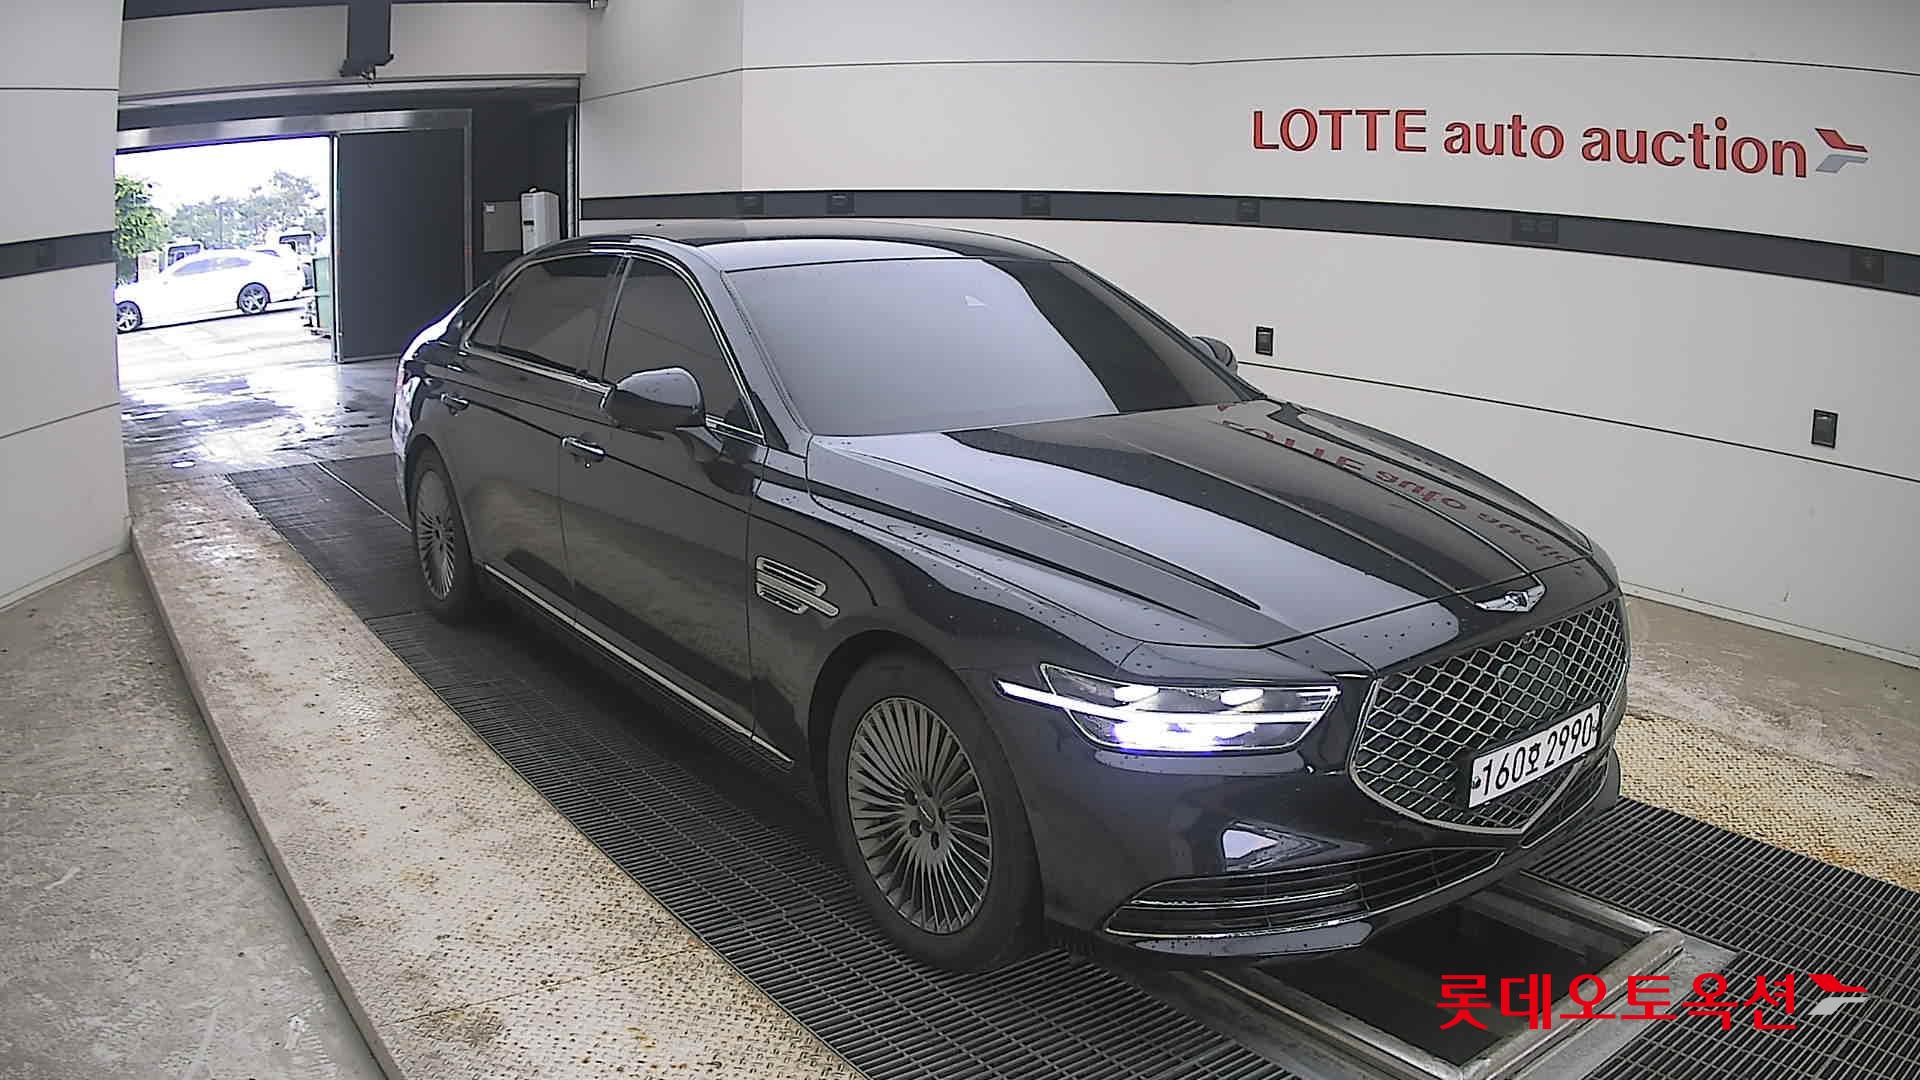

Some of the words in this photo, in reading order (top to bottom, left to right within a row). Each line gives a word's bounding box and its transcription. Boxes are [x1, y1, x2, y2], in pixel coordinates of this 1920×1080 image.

[1252, 109, 1428, 153] LOTTE
[1443, 114, 1566, 160] auto
[1581, 117, 1808, 179] auction
[1483, 741, 1542, 796] 160호
[1544, 712, 1593, 769] 2990
